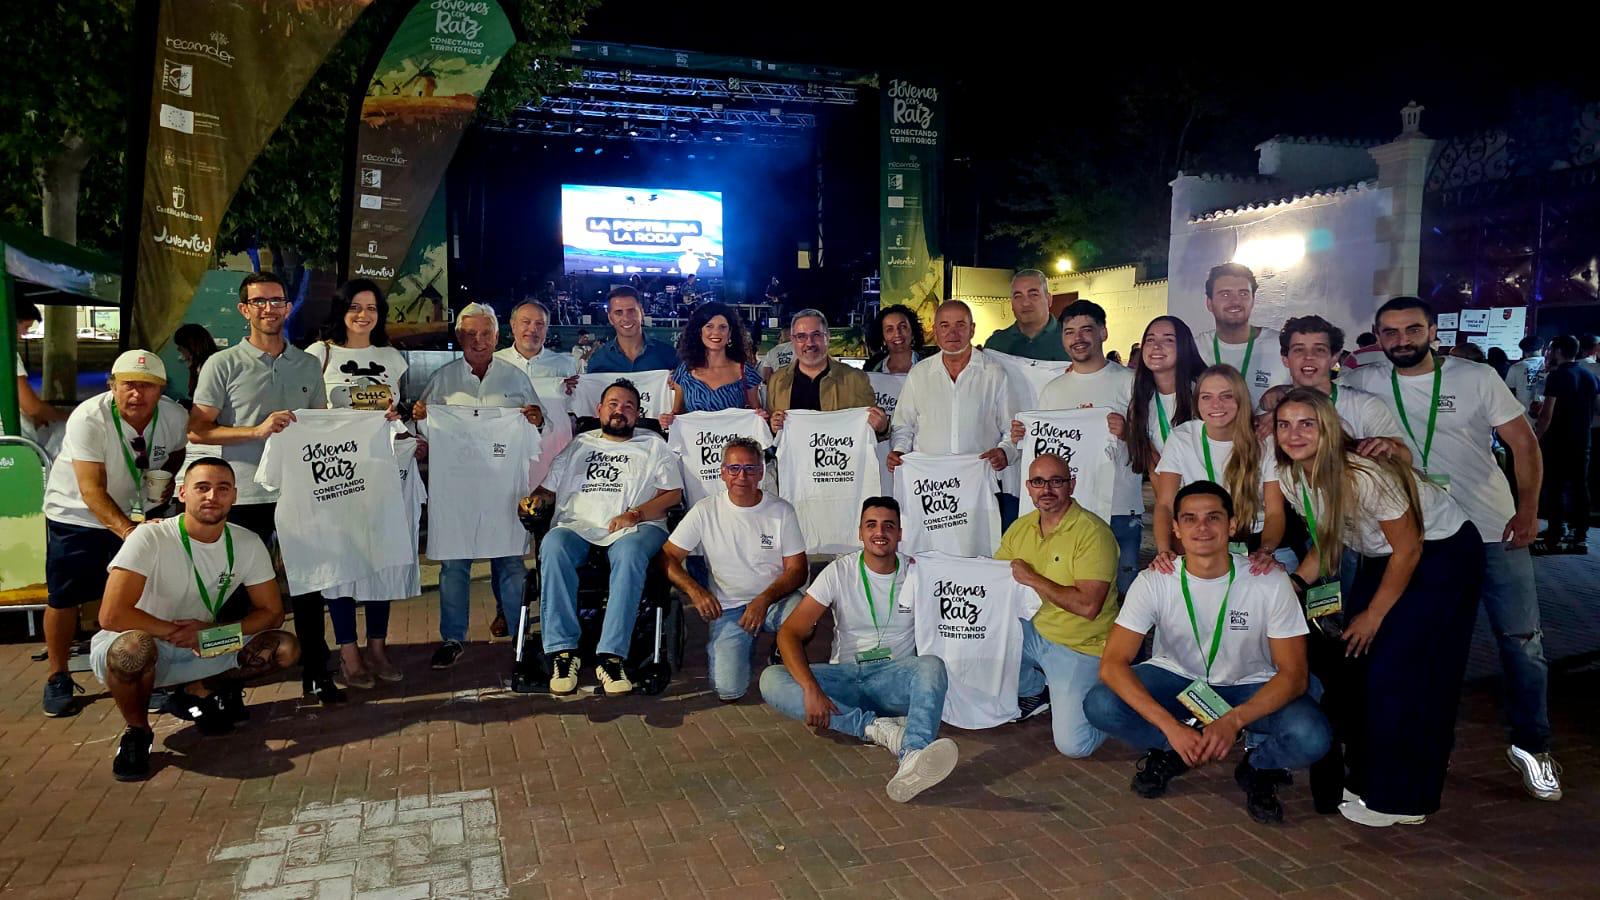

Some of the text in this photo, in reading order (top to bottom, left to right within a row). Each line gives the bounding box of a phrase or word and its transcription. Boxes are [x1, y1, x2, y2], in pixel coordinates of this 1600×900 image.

[436, 10, 483, 40] Raíz
[430, 36, 484, 48] CONECTANDO
[430, 44, 482, 54] TERRITORIOS
[888, 79, 940, 102] Jóvenes
[894, 98, 934, 129] Raíz
[890, 128, 938, 138] CONECTANDO
[891, 136, 937, 144] TERRITORIOS
[153, 225, 212, 253] Juventud
[614, 232, 678, 244] LA RODA
[355, 264, 394, 278] Juventud
[875, 392, 898, 406] Jóve
[1030, 421, 1082, 440] Jóvenes
[810, 432, 854, 448] Jóvenes
[302, 440, 358, 462] Jóvenes
[585, 450, 631, 464] Jóvenes
[702, 446, 721, 465] Ra
[814, 448, 850, 470] Raíz
[312, 458, 357, 484] Raíz
[586, 462, 622, 482] Raíz
[313, 478, 364, 496] CONECTANDO
[316, 484, 366, 502] TERRITORIOS
[914, 478, 960, 495] Jóvenes
[922, 494, 960, 515] Raíz
[924, 512, 968, 525] CONECTANDO
[926, 519, 968, 531] TERRITORIOS
[934, 580, 986, 598] Jóvenes
[940, 598, 982, 625] Raíz
[940, 632, 985, 640] TERRITORIOS
